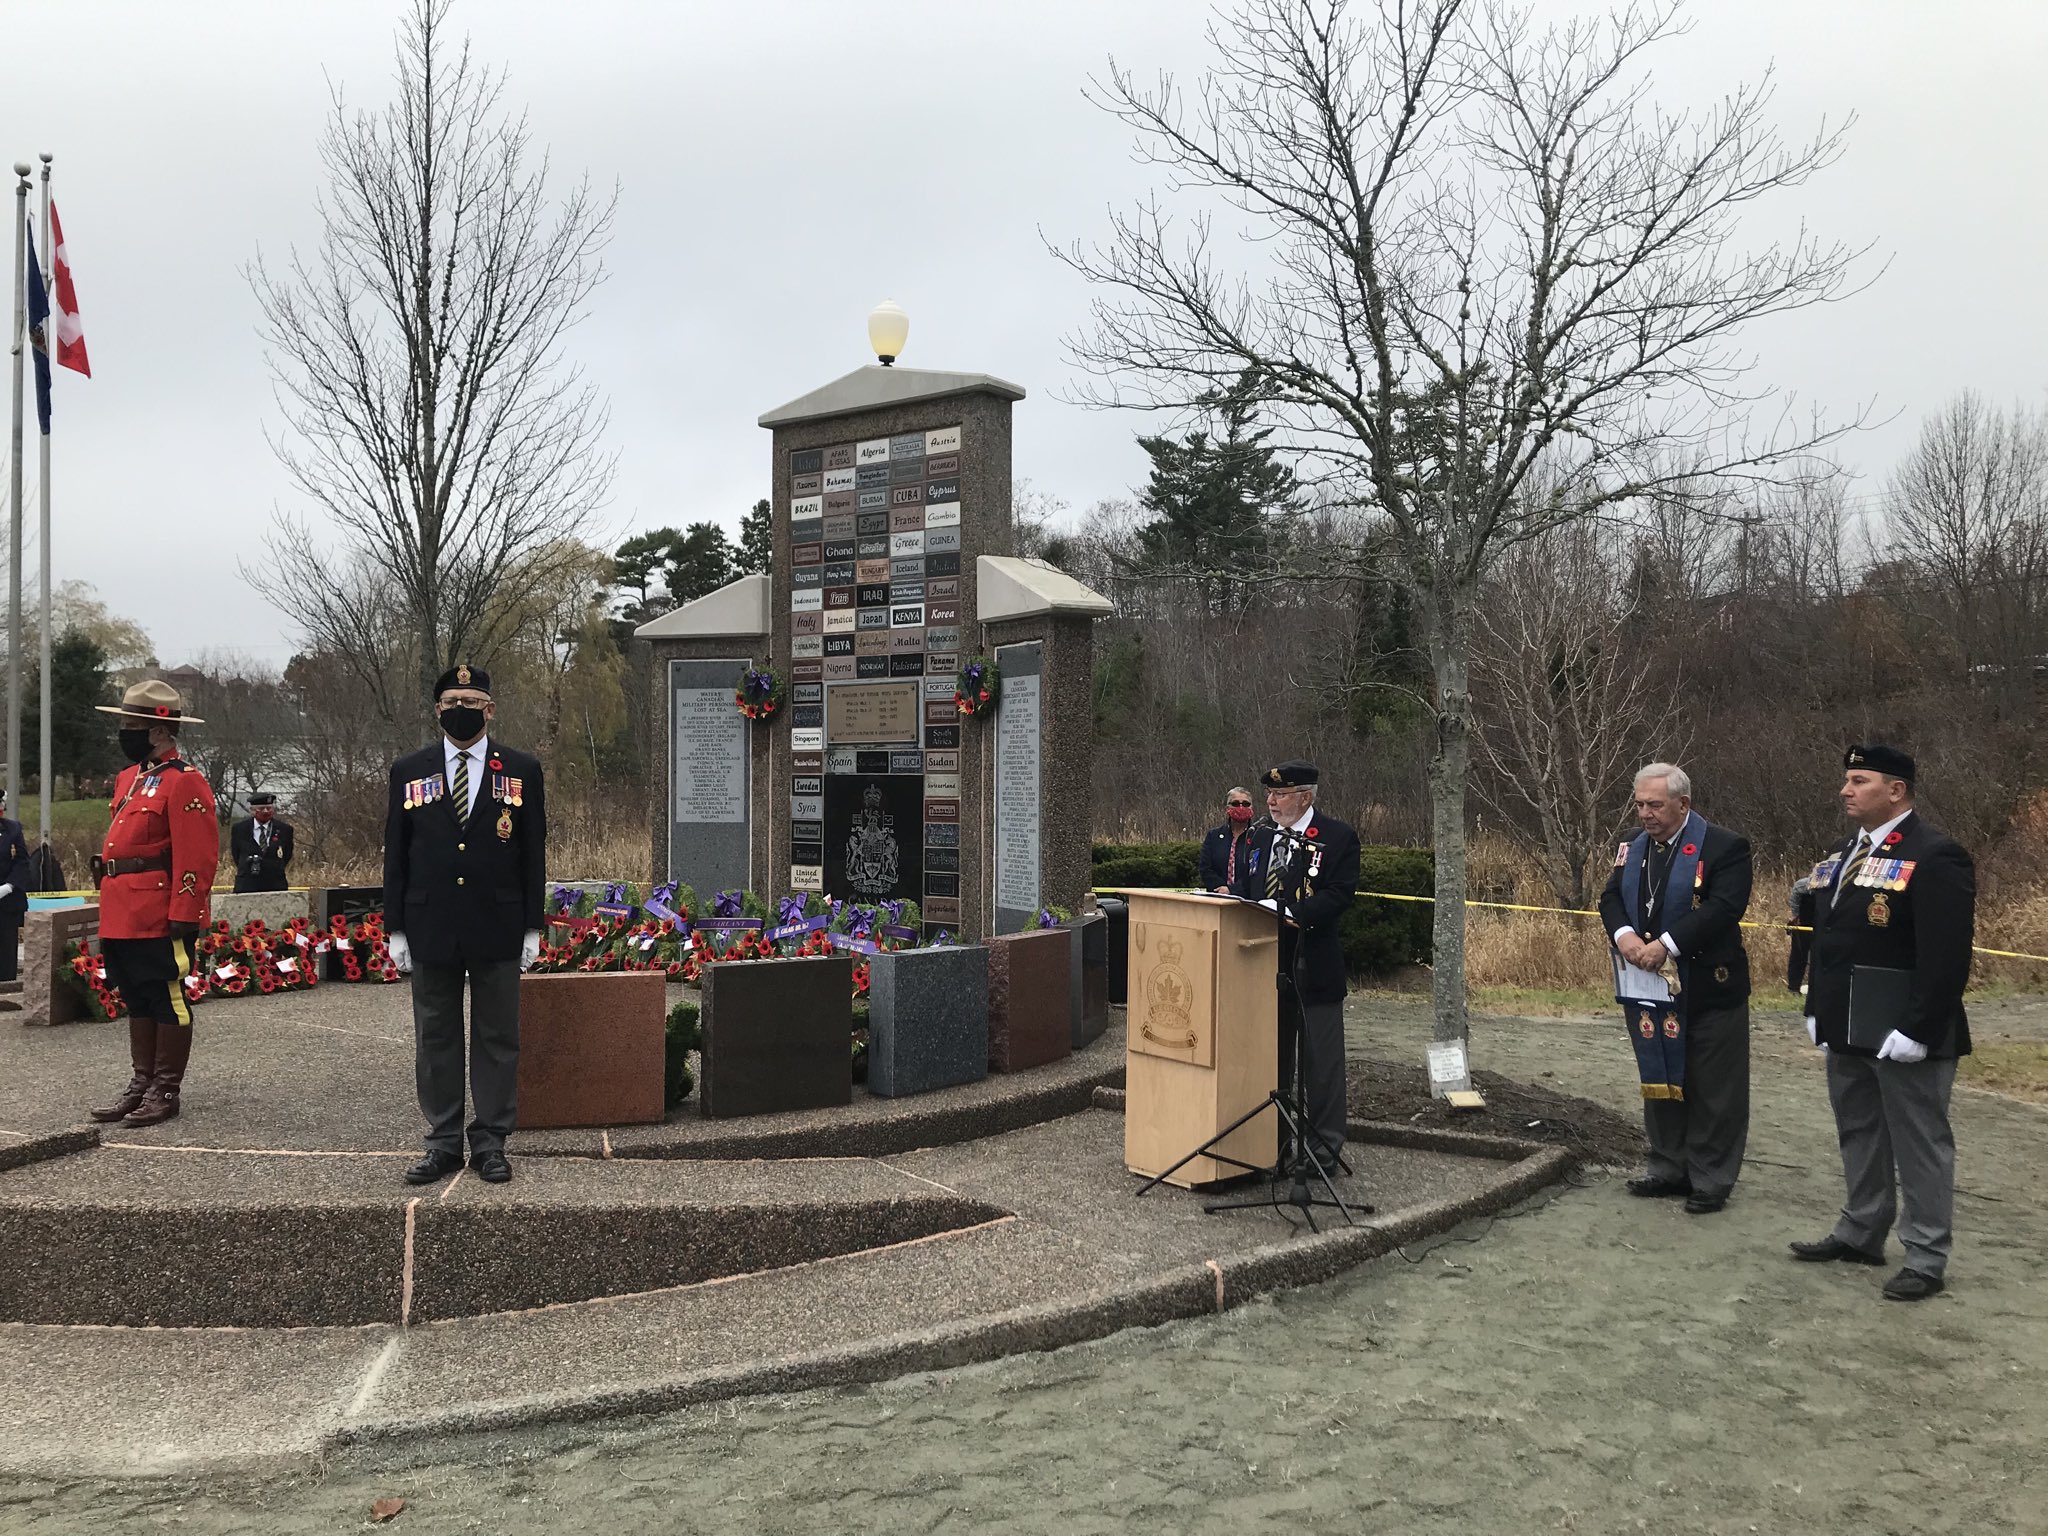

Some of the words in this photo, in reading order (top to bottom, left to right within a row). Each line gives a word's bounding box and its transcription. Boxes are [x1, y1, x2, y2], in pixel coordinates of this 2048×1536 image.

[894, 443, 921, 452] AUSTRALIA
[930, 436, 957, 448] Austria
[830, 448, 849, 458] AFARS
[860, 446, 886, 458] Algeria
[796, 480, 818, 490] Azores
[826, 476, 853, 487] Bahamas
[895, 488, 919, 503] CUBA
[928, 484, 957, 499] Cyprus
[827, 500, 851, 510] Bulgaria
[861, 494, 884, 505] BURMA
[794, 503, 819, 515] BRAZIL
[894, 515, 921, 526] France
[927, 510, 957, 522] Gambia
[860, 517, 885, 530] Egypt
[895, 538, 920, 551] Greece
[929, 535, 956, 546] GUINEA
[826, 546, 854, 557] Ghana
[860, 566, 886, 576] HUNGARY
[895, 563, 919, 574] Iceland
[795, 572, 819, 583] Guyana
[826, 570, 839, 579] Hong
[839, 570, 853, 578] Kong
[931, 583, 955, 596] Israel
[829, 591, 849, 605] Iran
[862, 589, 884, 602] IRAQ
[794, 597, 820, 606] Indonesia
[895, 610, 920, 623] KENYA
[930, 608, 955, 619] Korea
[796, 615, 817, 632] Italy
[827, 614, 853, 626] Jamaica
[862, 614, 883, 625] Japan
[827, 640, 851, 652] LIBYA
[894, 635, 921, 647] Malta
[892, 661, 922, 671] Pakistan
[930, 655, 956, 666] Panama
[826, 663, 852, 674] Nigeria
[859, 662, 885, 671] NORWAY
[795, 687, 820, 698] Poland
[929, 683, 955, 691] PORTUGAL
[932, 728, 952, 737] South
[794, 734, 820, 743] Singapore
[932, 737, 953, 746] Africa
[828, 754, 853, 769] Spain
[903, 758, 920, 767] LUCIA
[928, 756, 955, 768] Sudan
[796, 780, 819, 791] Sweden
[926, 782, 956, 790] Switzerland
[797, 802, 817, 815] Syria
[796, 869, 818, 877] United
[793, 876, 820, 886] Kingdom
